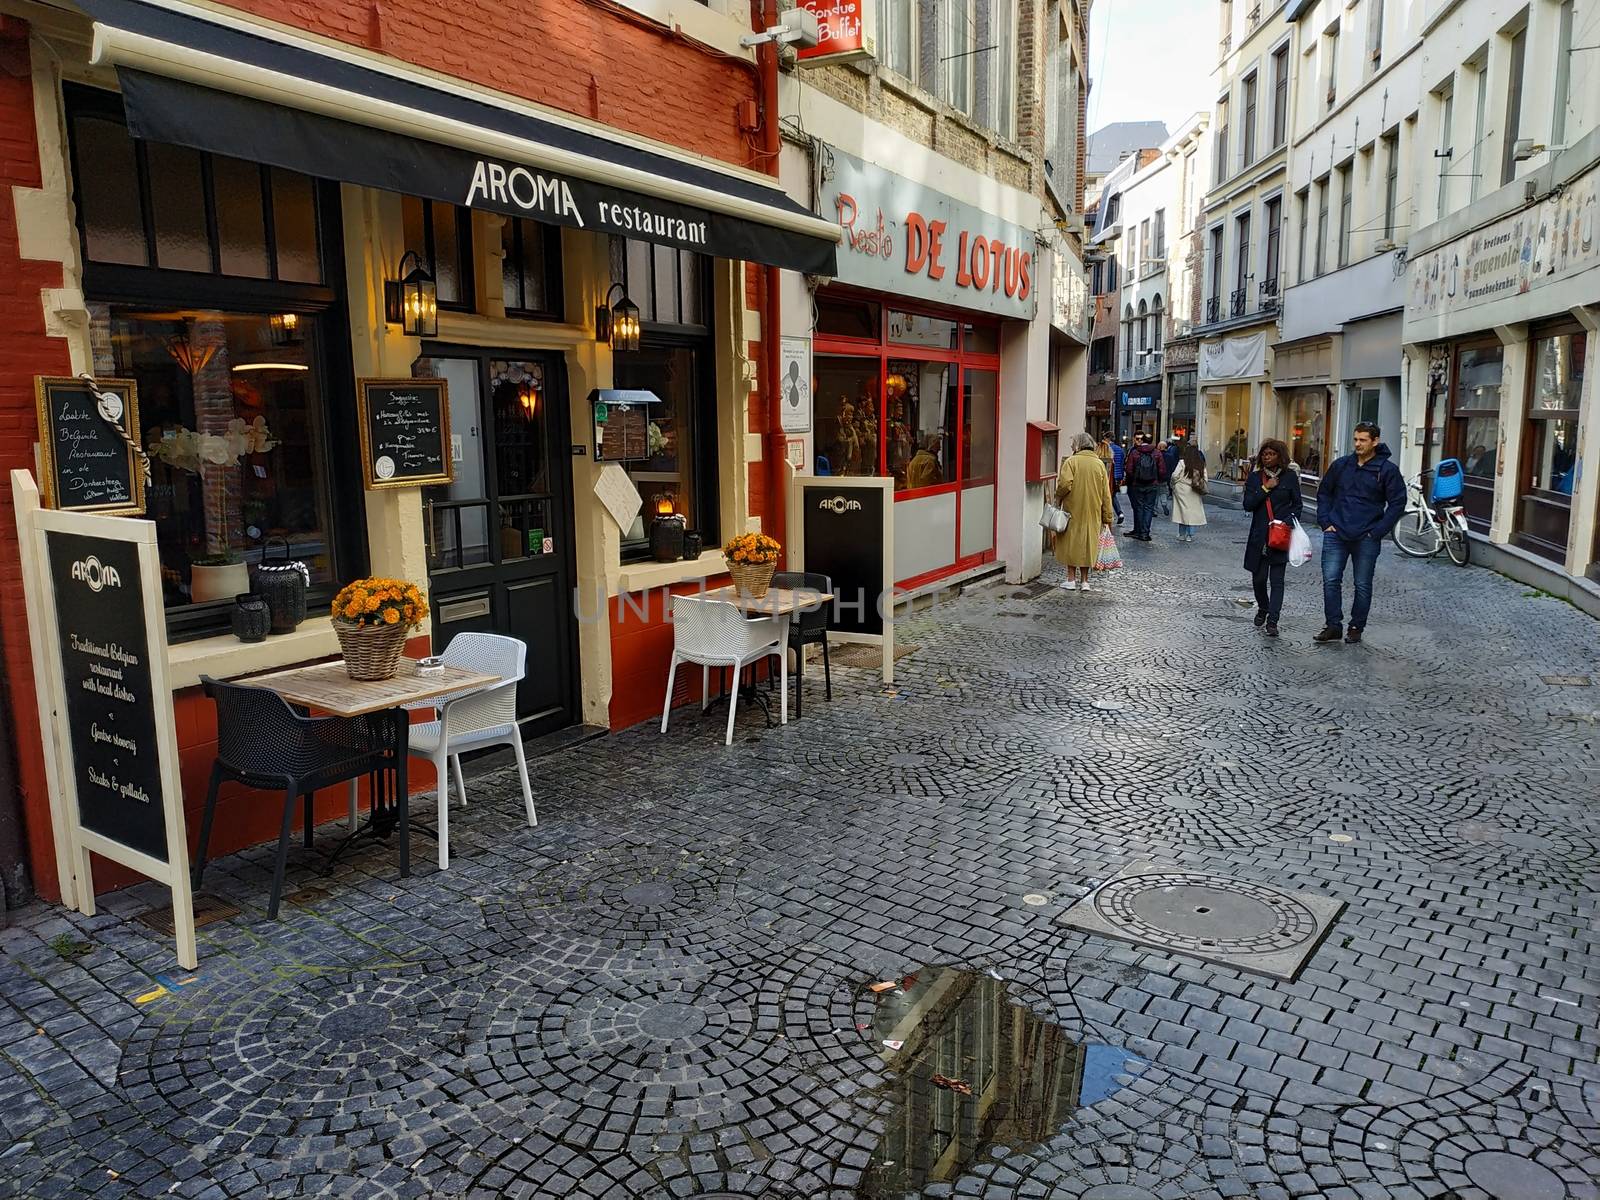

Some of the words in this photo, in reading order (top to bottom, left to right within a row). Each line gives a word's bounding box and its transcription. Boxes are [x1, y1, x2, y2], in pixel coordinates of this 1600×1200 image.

[817, 16, 861, 42] Buffet
[465, 161, 584, 227] AROMA
[599, 201, 707, 245] restaurant
[834, 192, 893, 260] Resto
[905, 211, 947, 280] DE
[956, 231, 1031, 300] LOTUS
[819, 496, 862, 513] AROMA
[72, 555, 121, 592] AROMA
[71, 633, 110, 658] Traditional
[110, 643, 138, 667] Belgian
[90, 662, 123, 680] restaurant
[82, 677, 97, 692] with
[97, 678, 113, 696] local
[114, 683, 136, 702] dishes
[88, 766, 110, 788] Steaks
[112, 776, 119, 791] &
[120, 782, 150, 803] grillades
